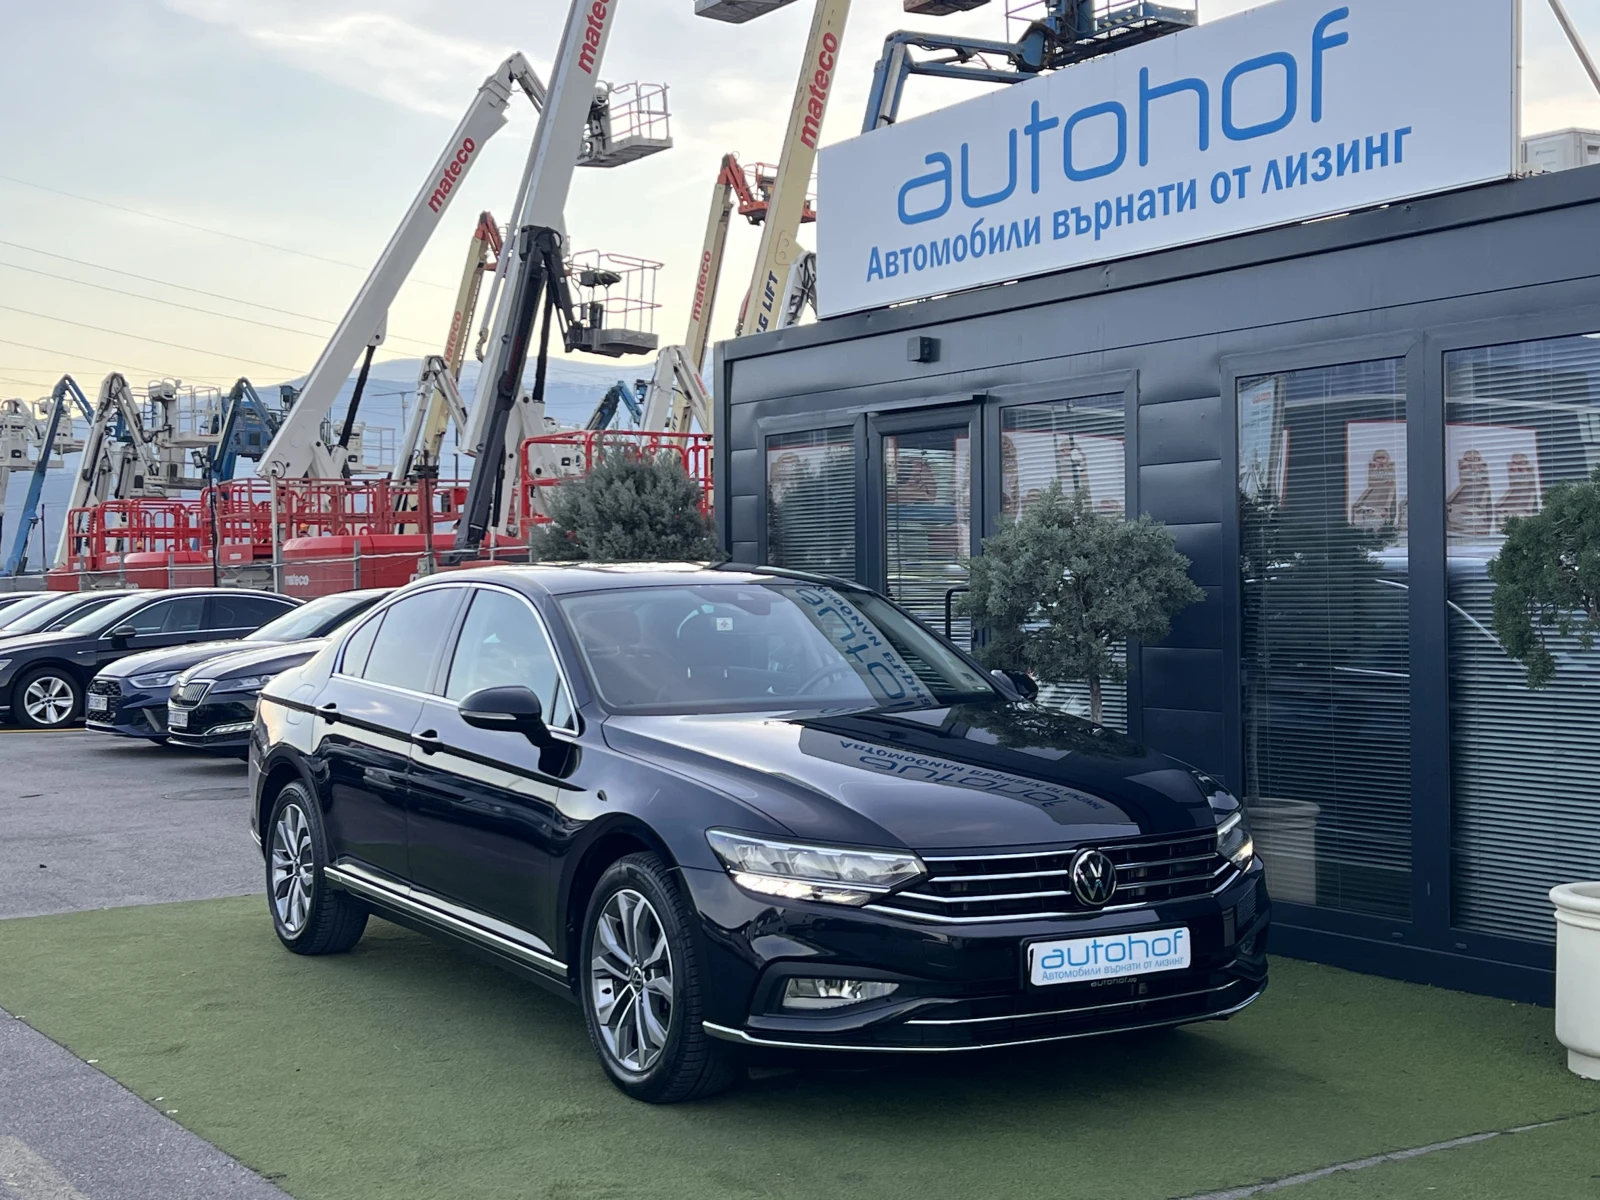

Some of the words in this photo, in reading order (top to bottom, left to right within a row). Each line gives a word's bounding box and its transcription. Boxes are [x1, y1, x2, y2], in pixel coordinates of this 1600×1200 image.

[578, 0, 610, 75] mate
[800, 32, 838, 149] mateco
[898, 7, 1348, 225] autohof
[428, 137, 475, 213] mateco
[867, 215, 1041, 282] Автомобили
[1052, 179, 1197, 241] върнати
[1209, 166, 1252, 205] от
[1261, 127, 1412, 193] лизинг
[692, 250, 711, 322] mateco
[762, 269, 778, 312] LIFT
[1041, 930, 1184, 970] autohof
[1042, 966, 1101, 981] Автомобили
[1104, 959, 1141, 975] върнати
[1143, 960, 1153, 970] от
[1154, 956, 1185, 968] лизинг
